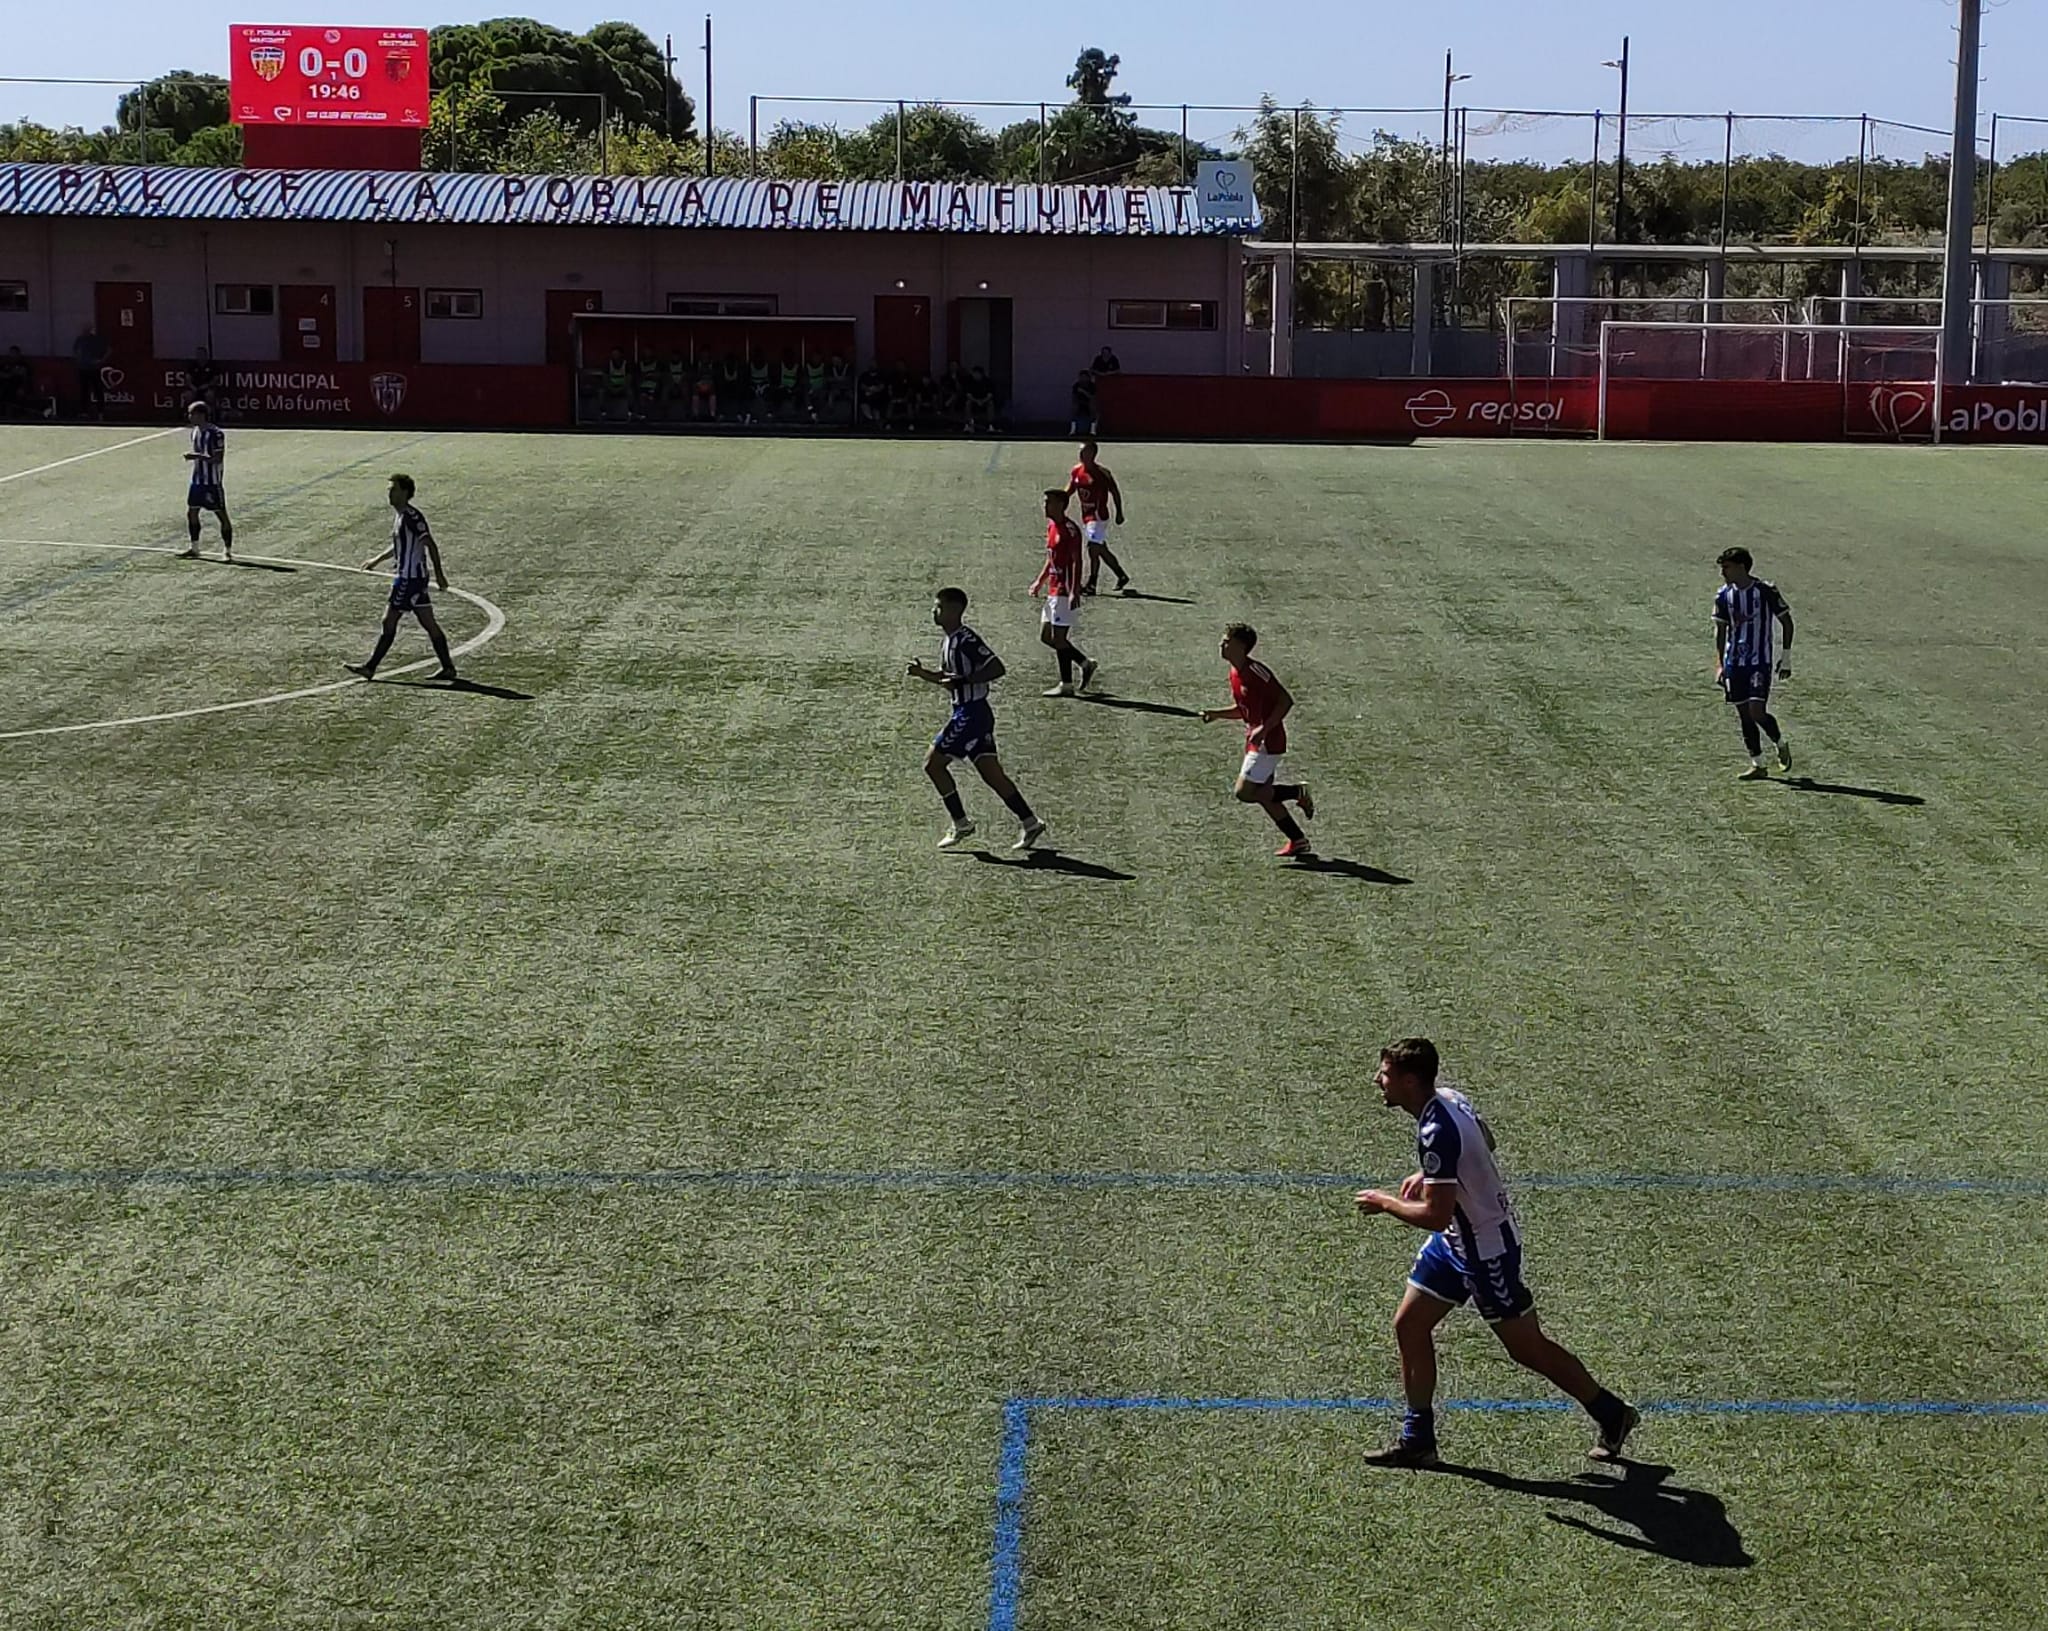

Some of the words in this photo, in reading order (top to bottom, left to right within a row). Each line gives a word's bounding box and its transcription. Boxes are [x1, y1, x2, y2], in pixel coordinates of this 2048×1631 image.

[309, 84, 360, 99] 19:46
[232, 172, 300, 207] CF
[368, 175, 439, 210] LA
[503, 177, 704, 215] POBLA
[769, 182, 842, 217] DE
[901, 184, 1192, 220] MAFUMET
[136, 290, 144, 302] 3
[320, 293, 328, 305] 4
[404, 296, 411, 308] 5
[586, 299, 594, 311] 6
[914, 304, 921, 316] 7
[236, 372, 340, 389] MUNICIPAL
[154, 392, 173, 408] La
[237, 394, 260, 409] de
[266, 394, 351, 412] Mafumet
[1467, 398, 1564, 424] repsol
